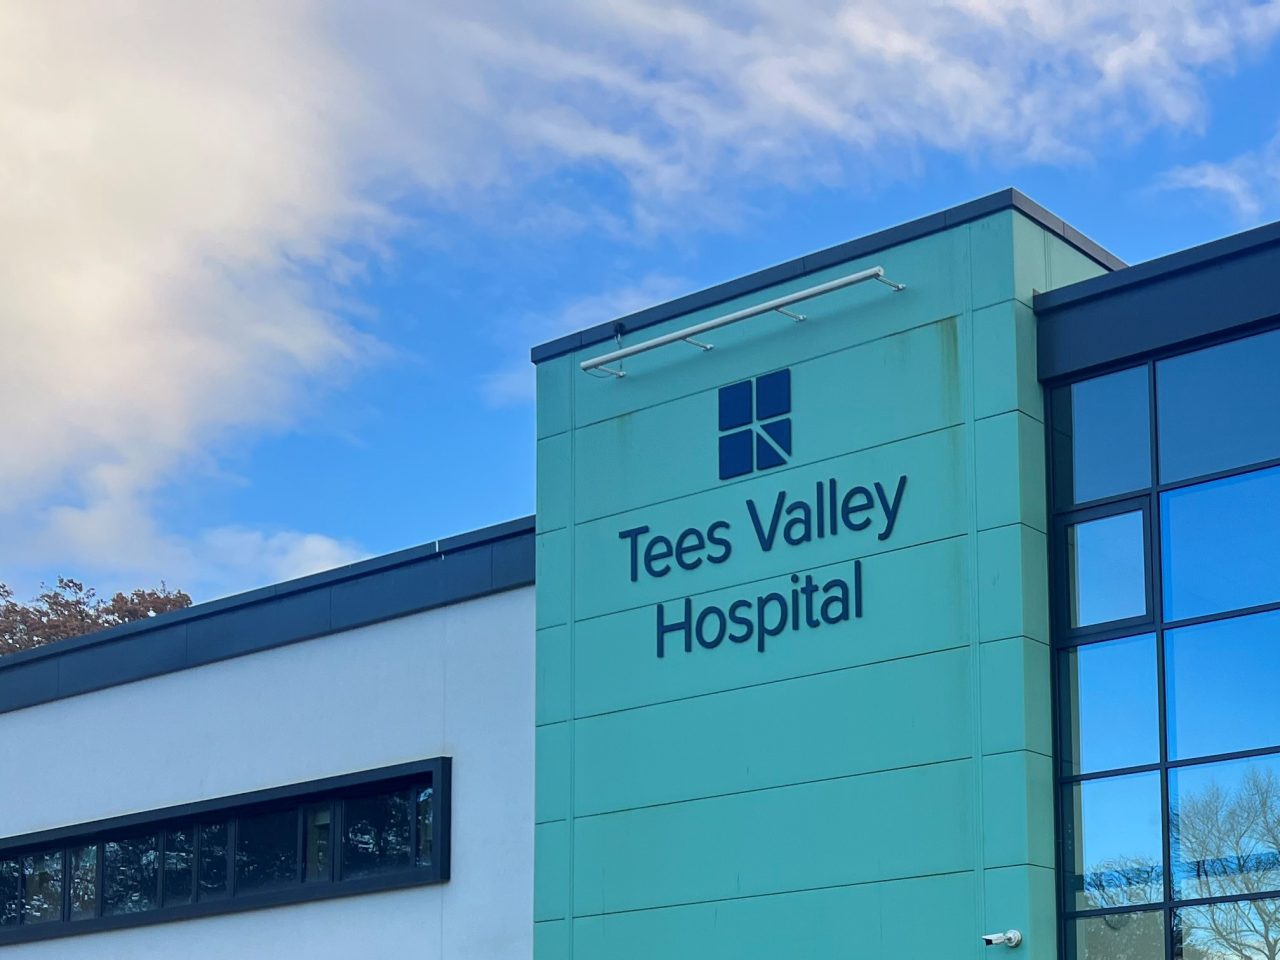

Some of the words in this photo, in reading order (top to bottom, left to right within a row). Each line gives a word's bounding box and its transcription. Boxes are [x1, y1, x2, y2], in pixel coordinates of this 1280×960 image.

[618, 520, 733, 582] Tees
[746, 475, 907, 552] Valley
[656, 560, 863, 658] Hospital
